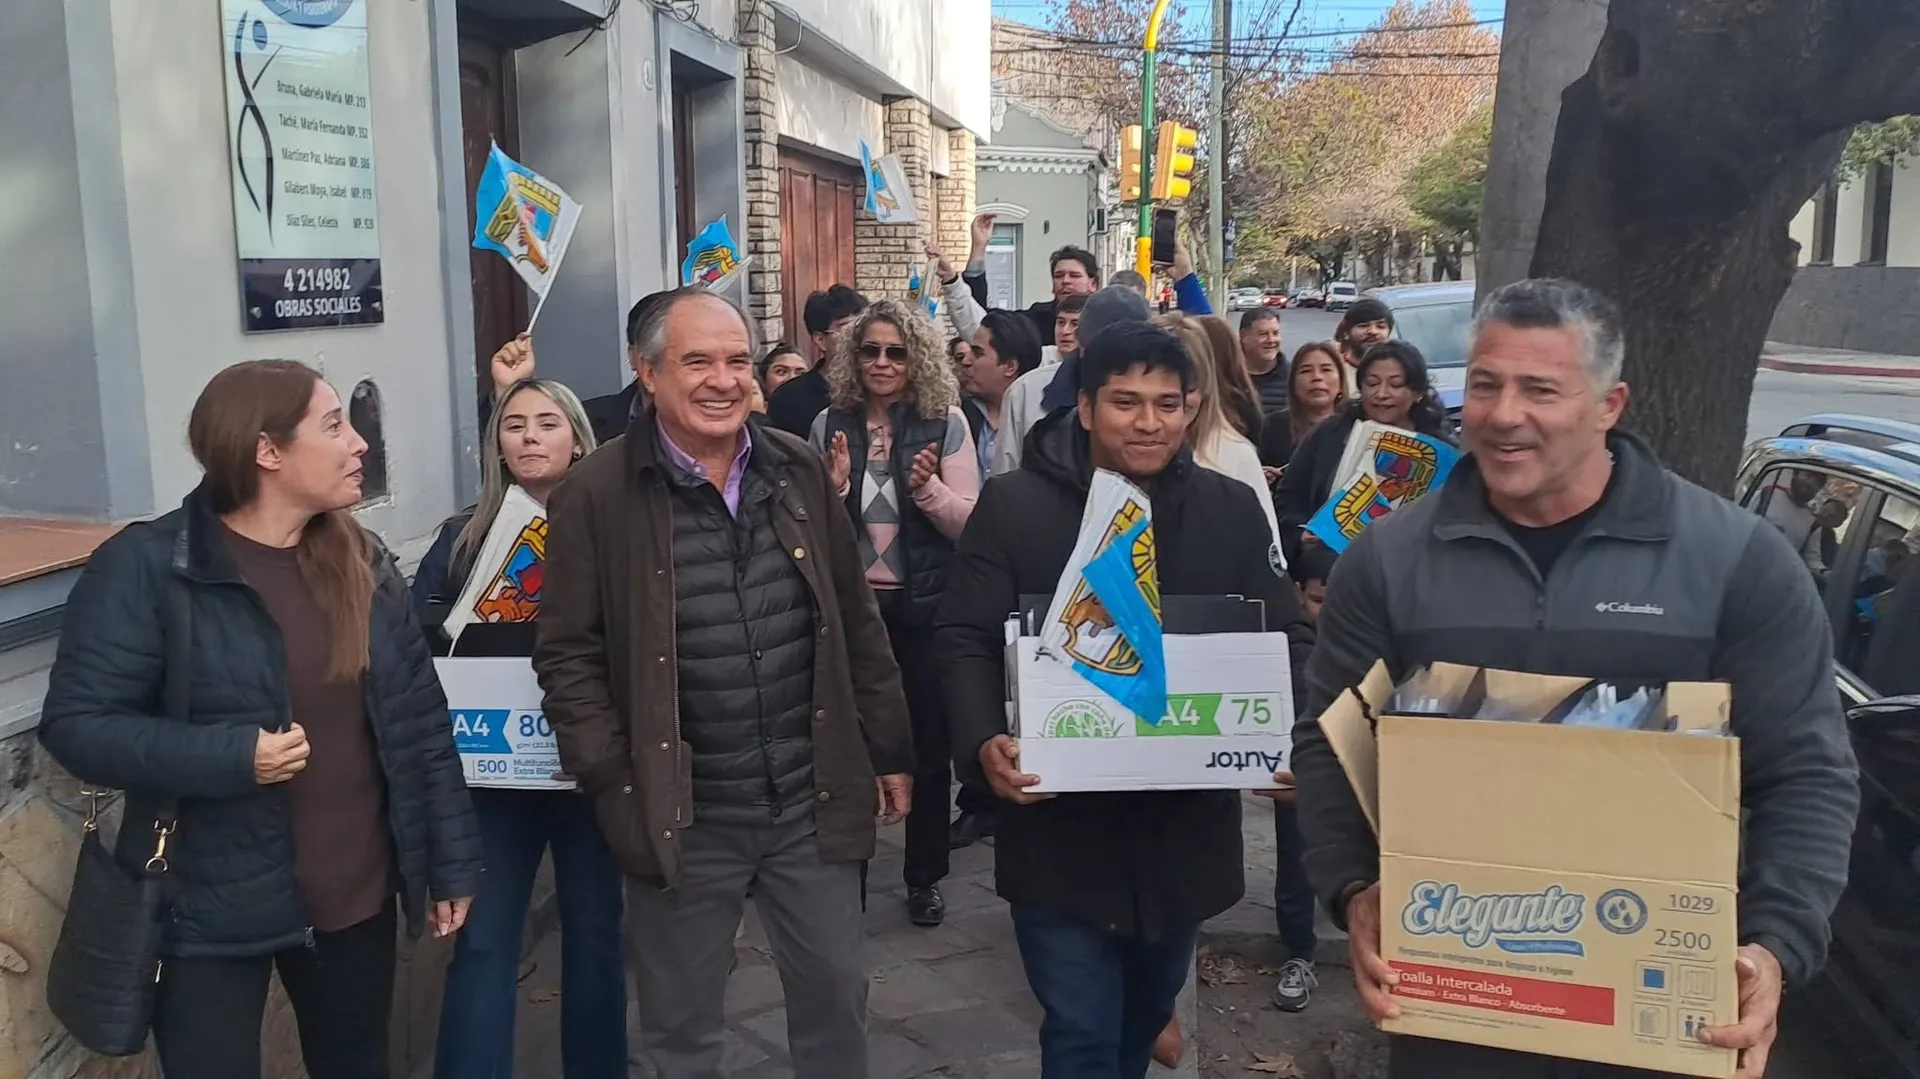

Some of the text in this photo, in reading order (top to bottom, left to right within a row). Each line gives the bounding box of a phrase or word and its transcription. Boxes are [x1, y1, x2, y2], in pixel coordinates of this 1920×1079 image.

[299, 84, 323, 100] Gabriela
[325, 89, 342, 104] María
[301, 116, 318, 132] María
[319, 120, 345, 135] Fernanda
[324, 153, 346, 166] Adriana
[275, 296, 361, 317] OBRAS SOCIALES
[1607, 601, 1664, 615] Columbia
[1159, 699, 1201, 726] A4
[1231, 698, 1271, 725] 75
[453, 714, 490, 736] A4
[520, 715, 556, 737] 80
[477, 760, 508, 773] 500
[513, 759, 560, 767] Multifunció
[513, 767, 534, 775] Extra
[1206, 751, 1283, 773] Autor
[1669, 893, 1714, 911] 1029
[1401, 880, 1586, 948] Elegante
[1654, 928, 1711, 951] 2500
[1394, 968, 1513, 996] Toalla Intercalada
[1393, 985, 1435, 998] Premium
[1443, 990, 1467, 1002] Extra
[1468, 993, 1501, 1006] Blanco
[1509, 1000, 1567, 1015] Absorbente
